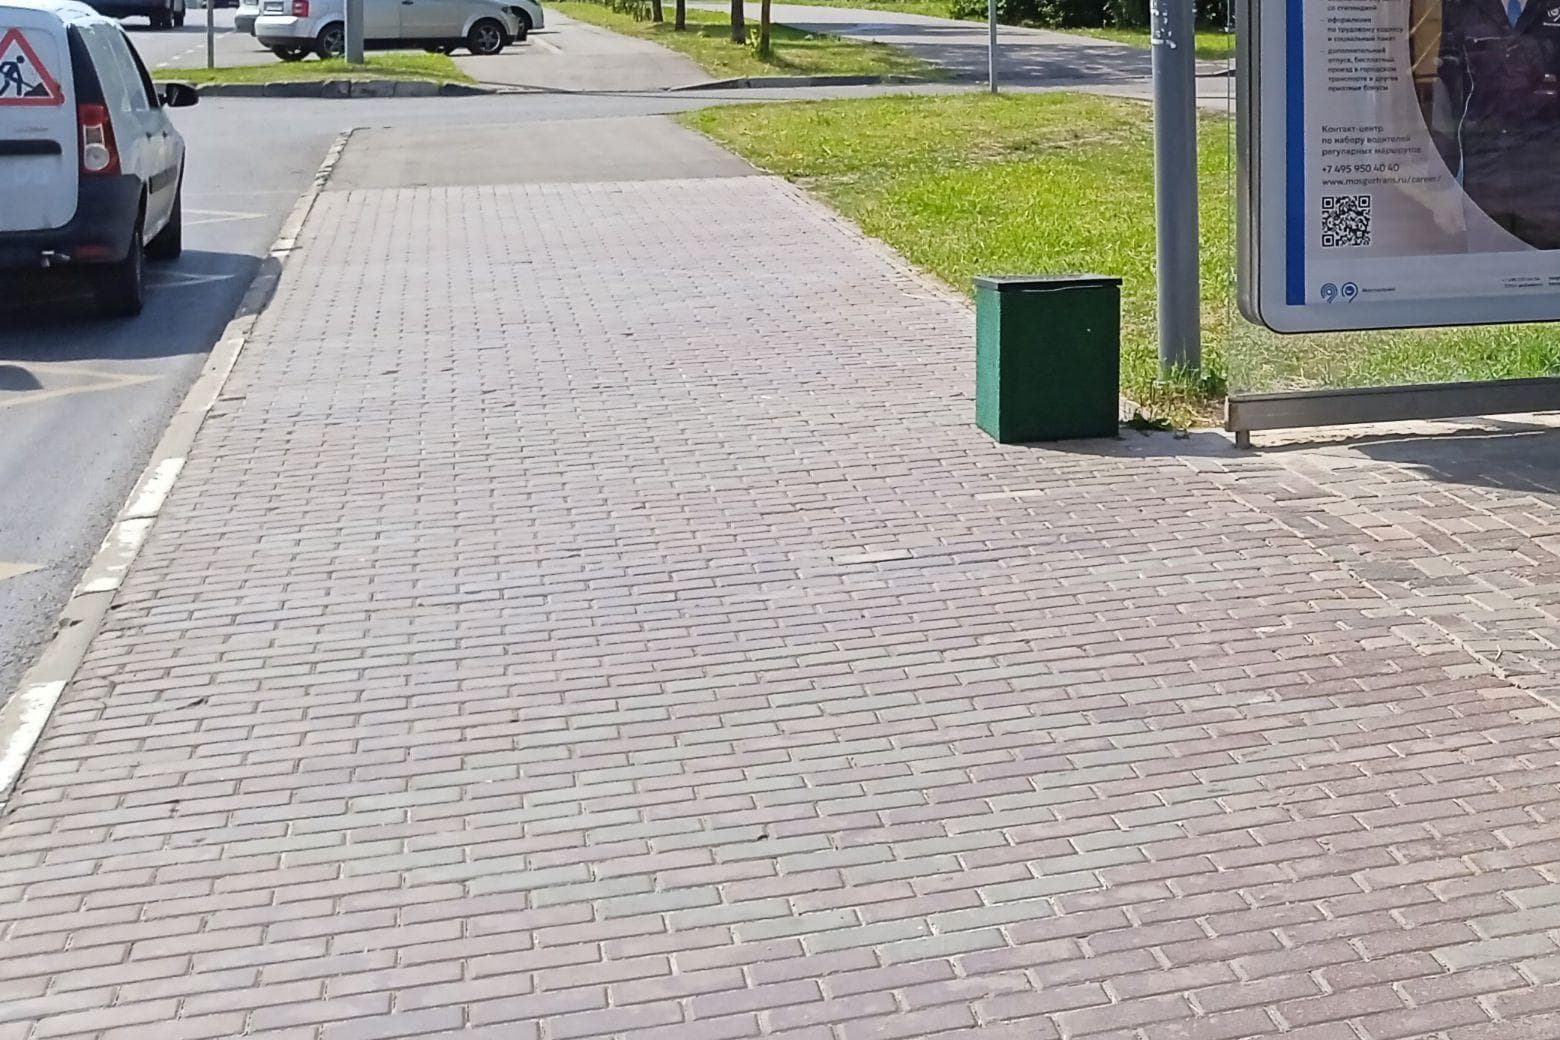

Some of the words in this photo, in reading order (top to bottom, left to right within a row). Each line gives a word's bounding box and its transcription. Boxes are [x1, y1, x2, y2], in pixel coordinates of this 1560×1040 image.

[1321, 125, 1385, 134] Контакт-центр
[1334, 135, 1365, 146] набору
[1321, 148, 1372, 157] регулярных
[1321, 165, 1333, 174] +7
[1334, 164, 1352, 173] 495
[1354, 164, 1372, 173] 950
[1373, 163, 1386, 173] 40
[1387, 163, 1400, 172] 40
